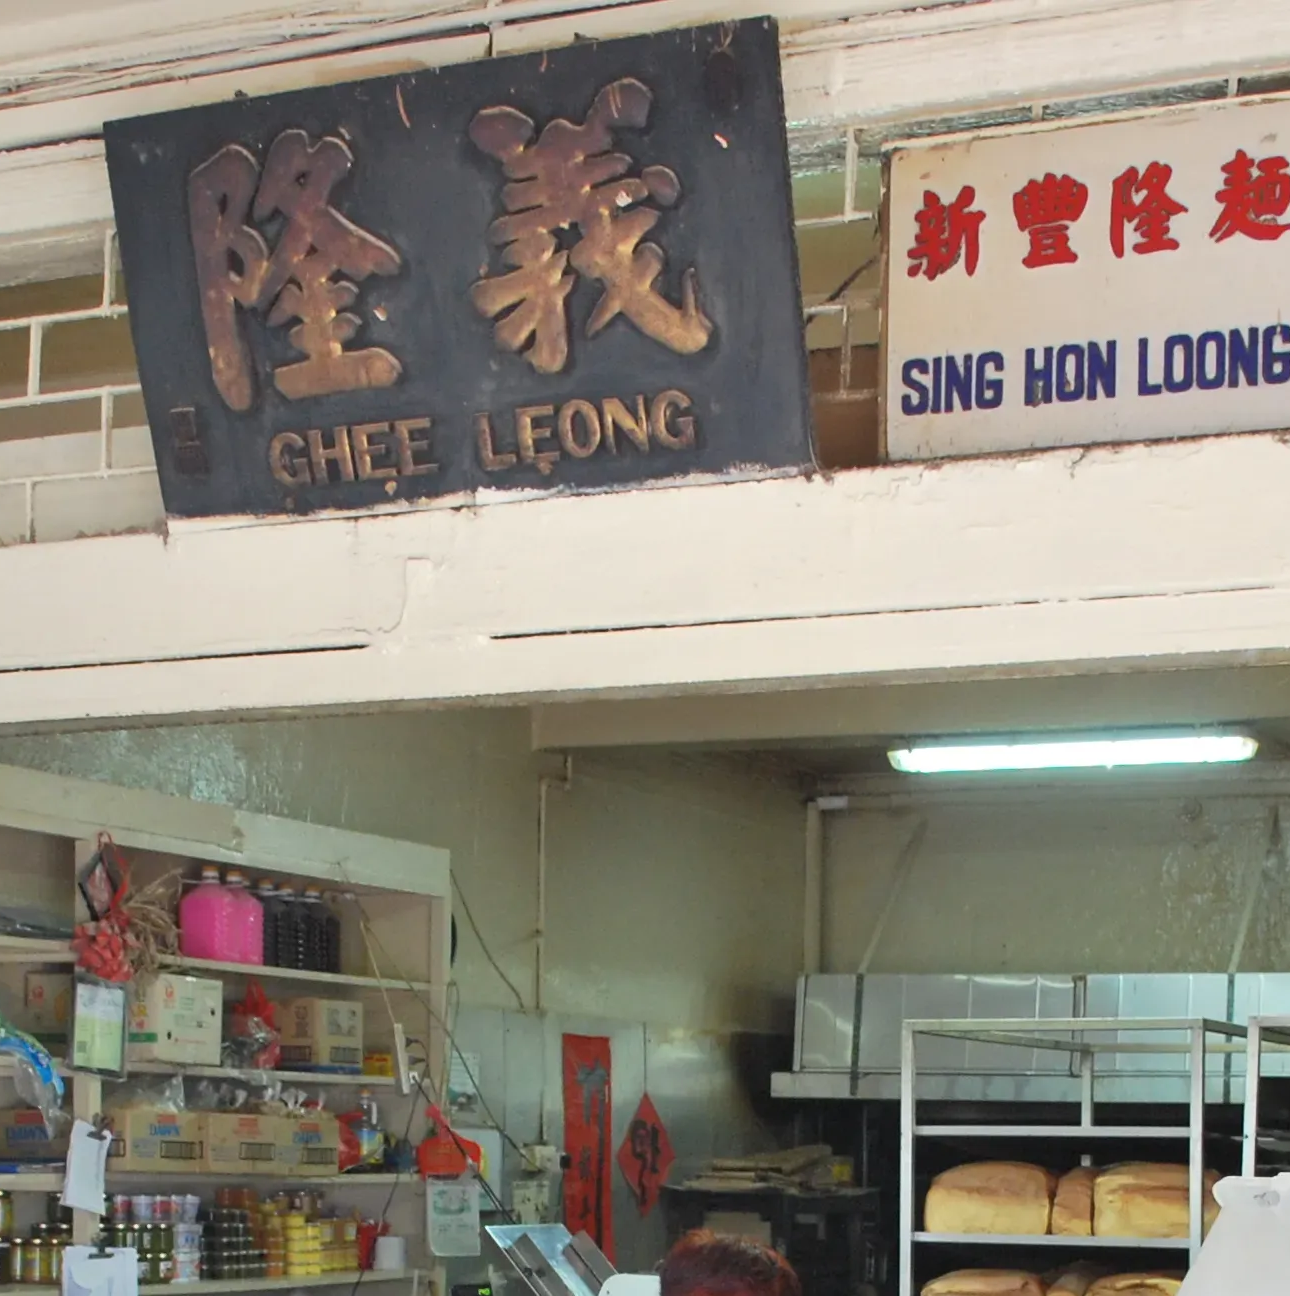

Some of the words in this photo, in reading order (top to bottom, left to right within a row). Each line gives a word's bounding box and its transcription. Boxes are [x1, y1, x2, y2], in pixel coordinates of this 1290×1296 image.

[901, 351, 1005, 416] SING
[1024, 339, 1117, 408] HON
[268, 417, 440, 486] GHEE
[475, 389, 697, 474] LEONG
